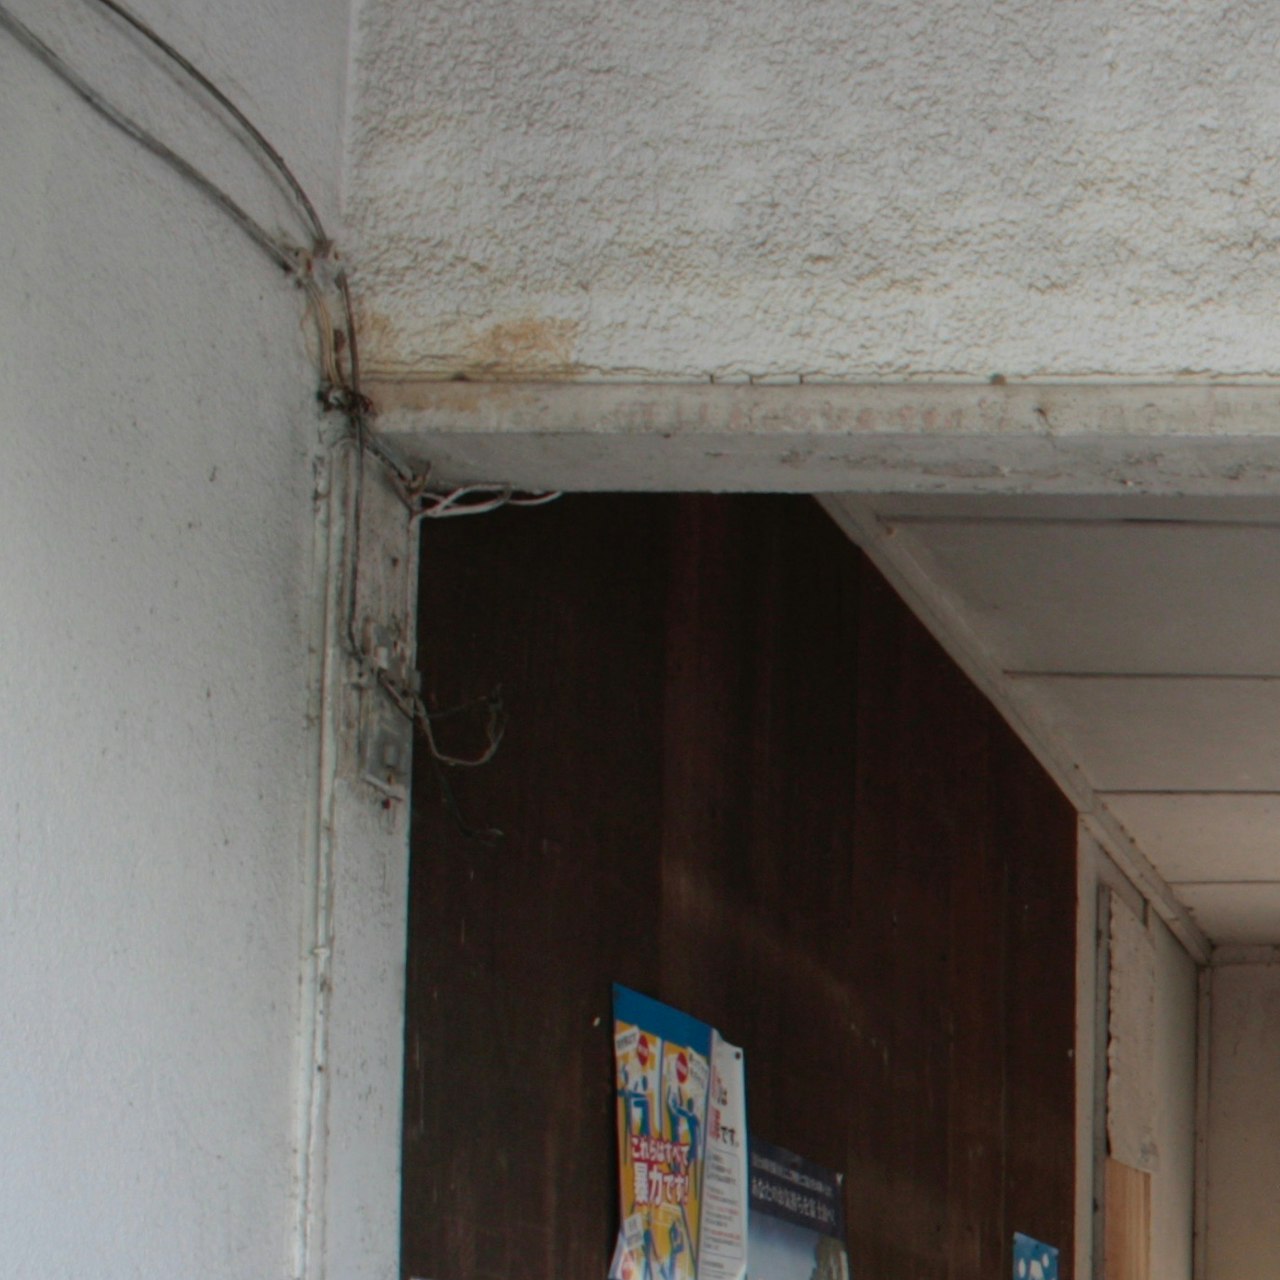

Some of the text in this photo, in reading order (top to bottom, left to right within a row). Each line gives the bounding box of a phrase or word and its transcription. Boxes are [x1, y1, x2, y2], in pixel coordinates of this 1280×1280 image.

[631, 1135, 691, 1165] これらはすべて
